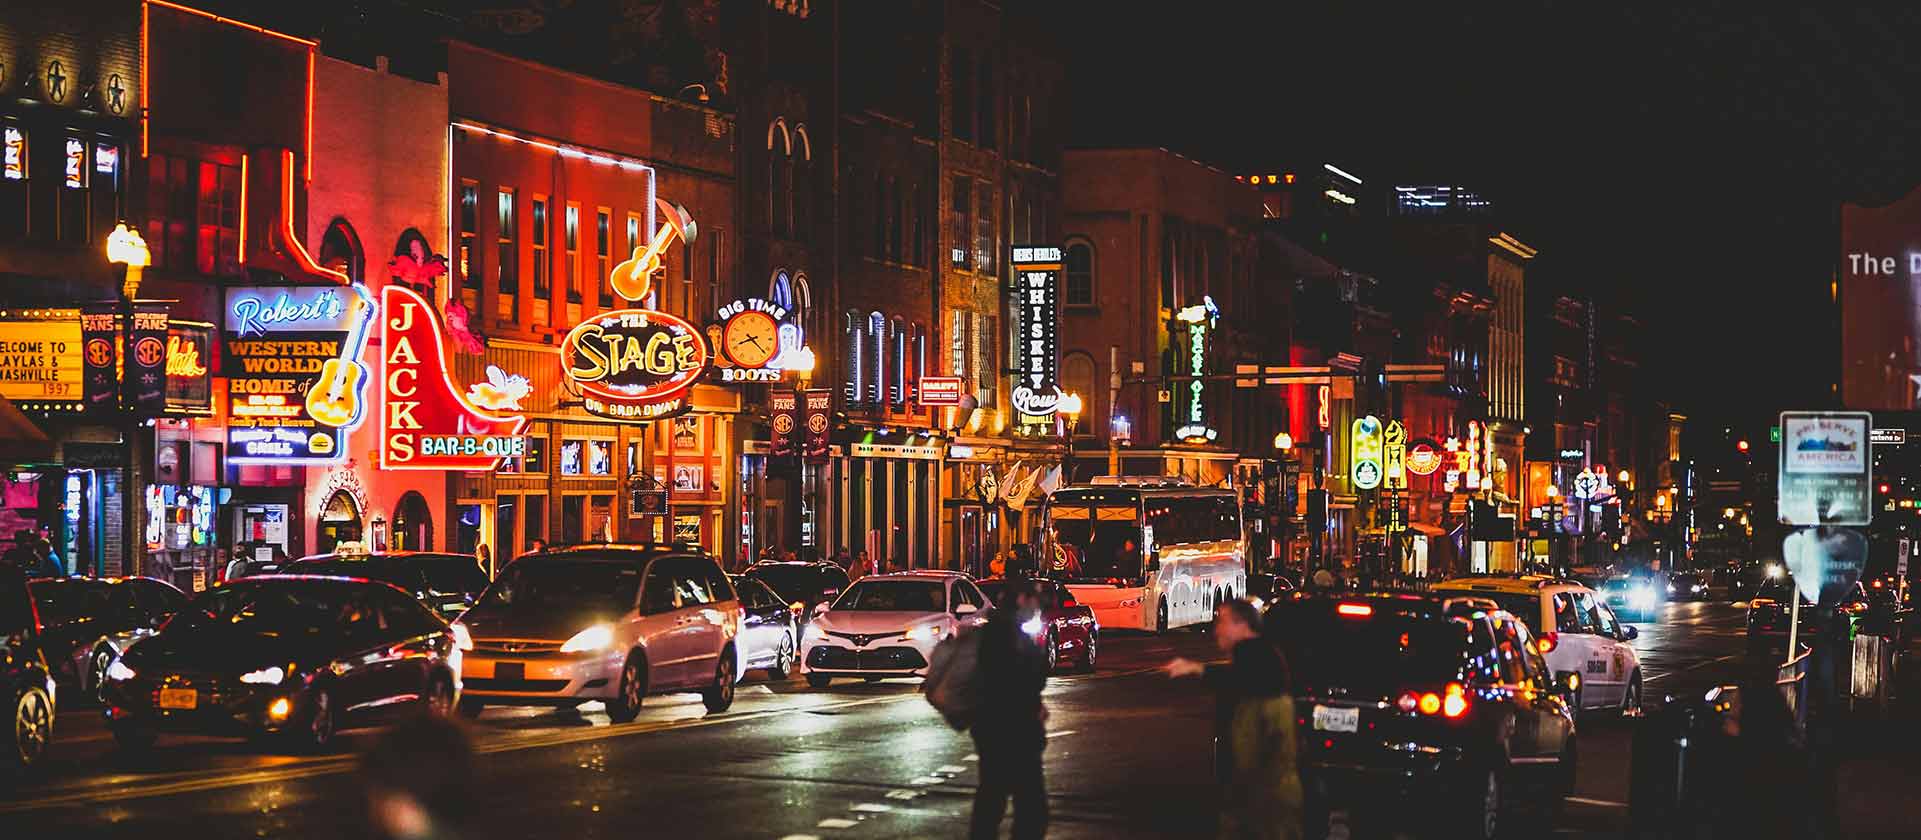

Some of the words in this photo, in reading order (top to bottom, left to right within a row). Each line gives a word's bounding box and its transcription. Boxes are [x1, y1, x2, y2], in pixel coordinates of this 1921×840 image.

[1848, 252, 1896, 275] The
[233, 290, 342, 337] Robert's
[718, 300, 745, 320] BIG
[748, 298, 787, 320] TIME
[82, 320, 114, 332] FANS
[134, 319, 168, 331] FANS
[620, 314, 648, 328] THE
[1027, 272, 1048, 389] WHISKEY
[50, 342, 66, 354] TO
[228, 341, 338, 356] WESTERN
[570, 324, 700, 382] STAGE
[0, 356, 44, 368] AYLAS
[51, 356, 58, 367] &
[242, 358, 323, 373] WORLD
[388, 302, 423, 462] JACKS
[722, 368, 782, 382] BOOTS
[43, 384, 70, 396] 1997
[230, 379, 296, 394] HOME
[297, 379, 312, 397] of
[808, 401, 829, 409] FANS
[1018, 387, 1057, 409] Row
[585, 398, 604, 413] ON
[609, 399, 681, 417] BROADWAY
[774, 402, 796, 410] FANS
[421, 437, 524, 456] BAR-B-QUE
